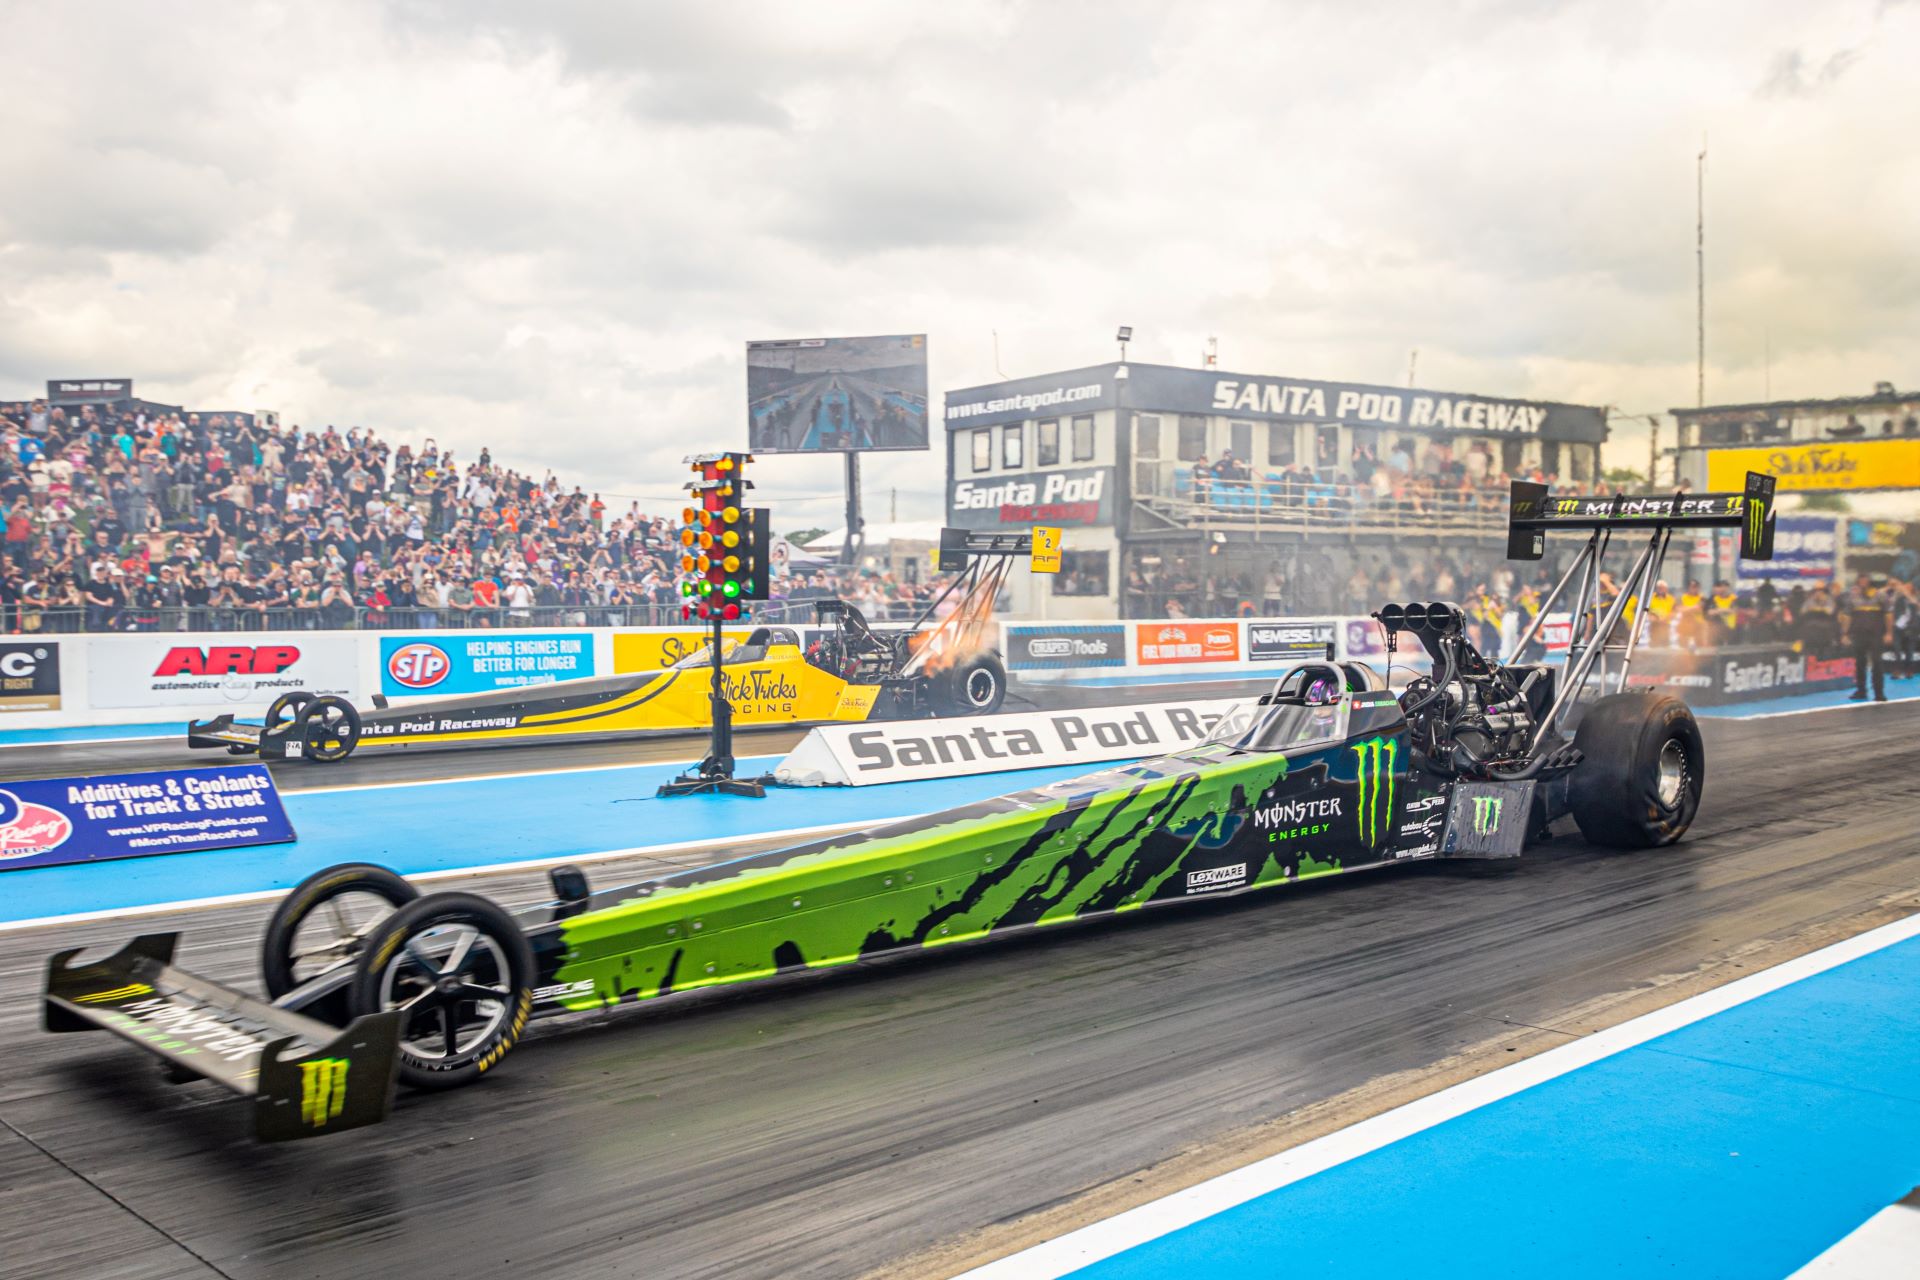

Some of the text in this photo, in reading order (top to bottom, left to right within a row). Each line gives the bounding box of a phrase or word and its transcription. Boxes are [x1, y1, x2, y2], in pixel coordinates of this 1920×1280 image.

[947, 384, 1101, 419] www.santapod.com
[1212, 380, 1547, 433] SANTA POD RACEWAY
[953, 470, 1105, 510] Santa Pod
[1045, 537, 1052, 549] 2
[152, 645, 301, 677] ARP
[466, 639, 582, 657] HELPING ENGINES RUN
[1072, 640, 1108, 655] Tools
[396, 649, 443, 678] STP
[473, 656, 577, 672] BETTER FOR LONGER
[1724, 661, 1773, 693] Santa
[1775, 655, 1804, 685] Pod
[151, 680, 220, 690] automotive
[254, 677, 304, 689] products
[750, 669, 796, 700] Tricks
[400, 720, 435, 733] Pod
[440, 716, 517, 730] Raceway
[847, 725, 1043, 772] Santa
[1051, 711, 1159, 752] Pod
[67, 773, 270, 804] Additives & Coolants
[85, 789, 266, 820] for Track & Street
[1254, 797, 1343, 830] MONSTER
[107, 813, 268, 837] www.VPRacingFuels.com
[128, 828, 259, 848] #MoreThanRaceFuel
[1269, 823, 1330, 842] ENERGY
